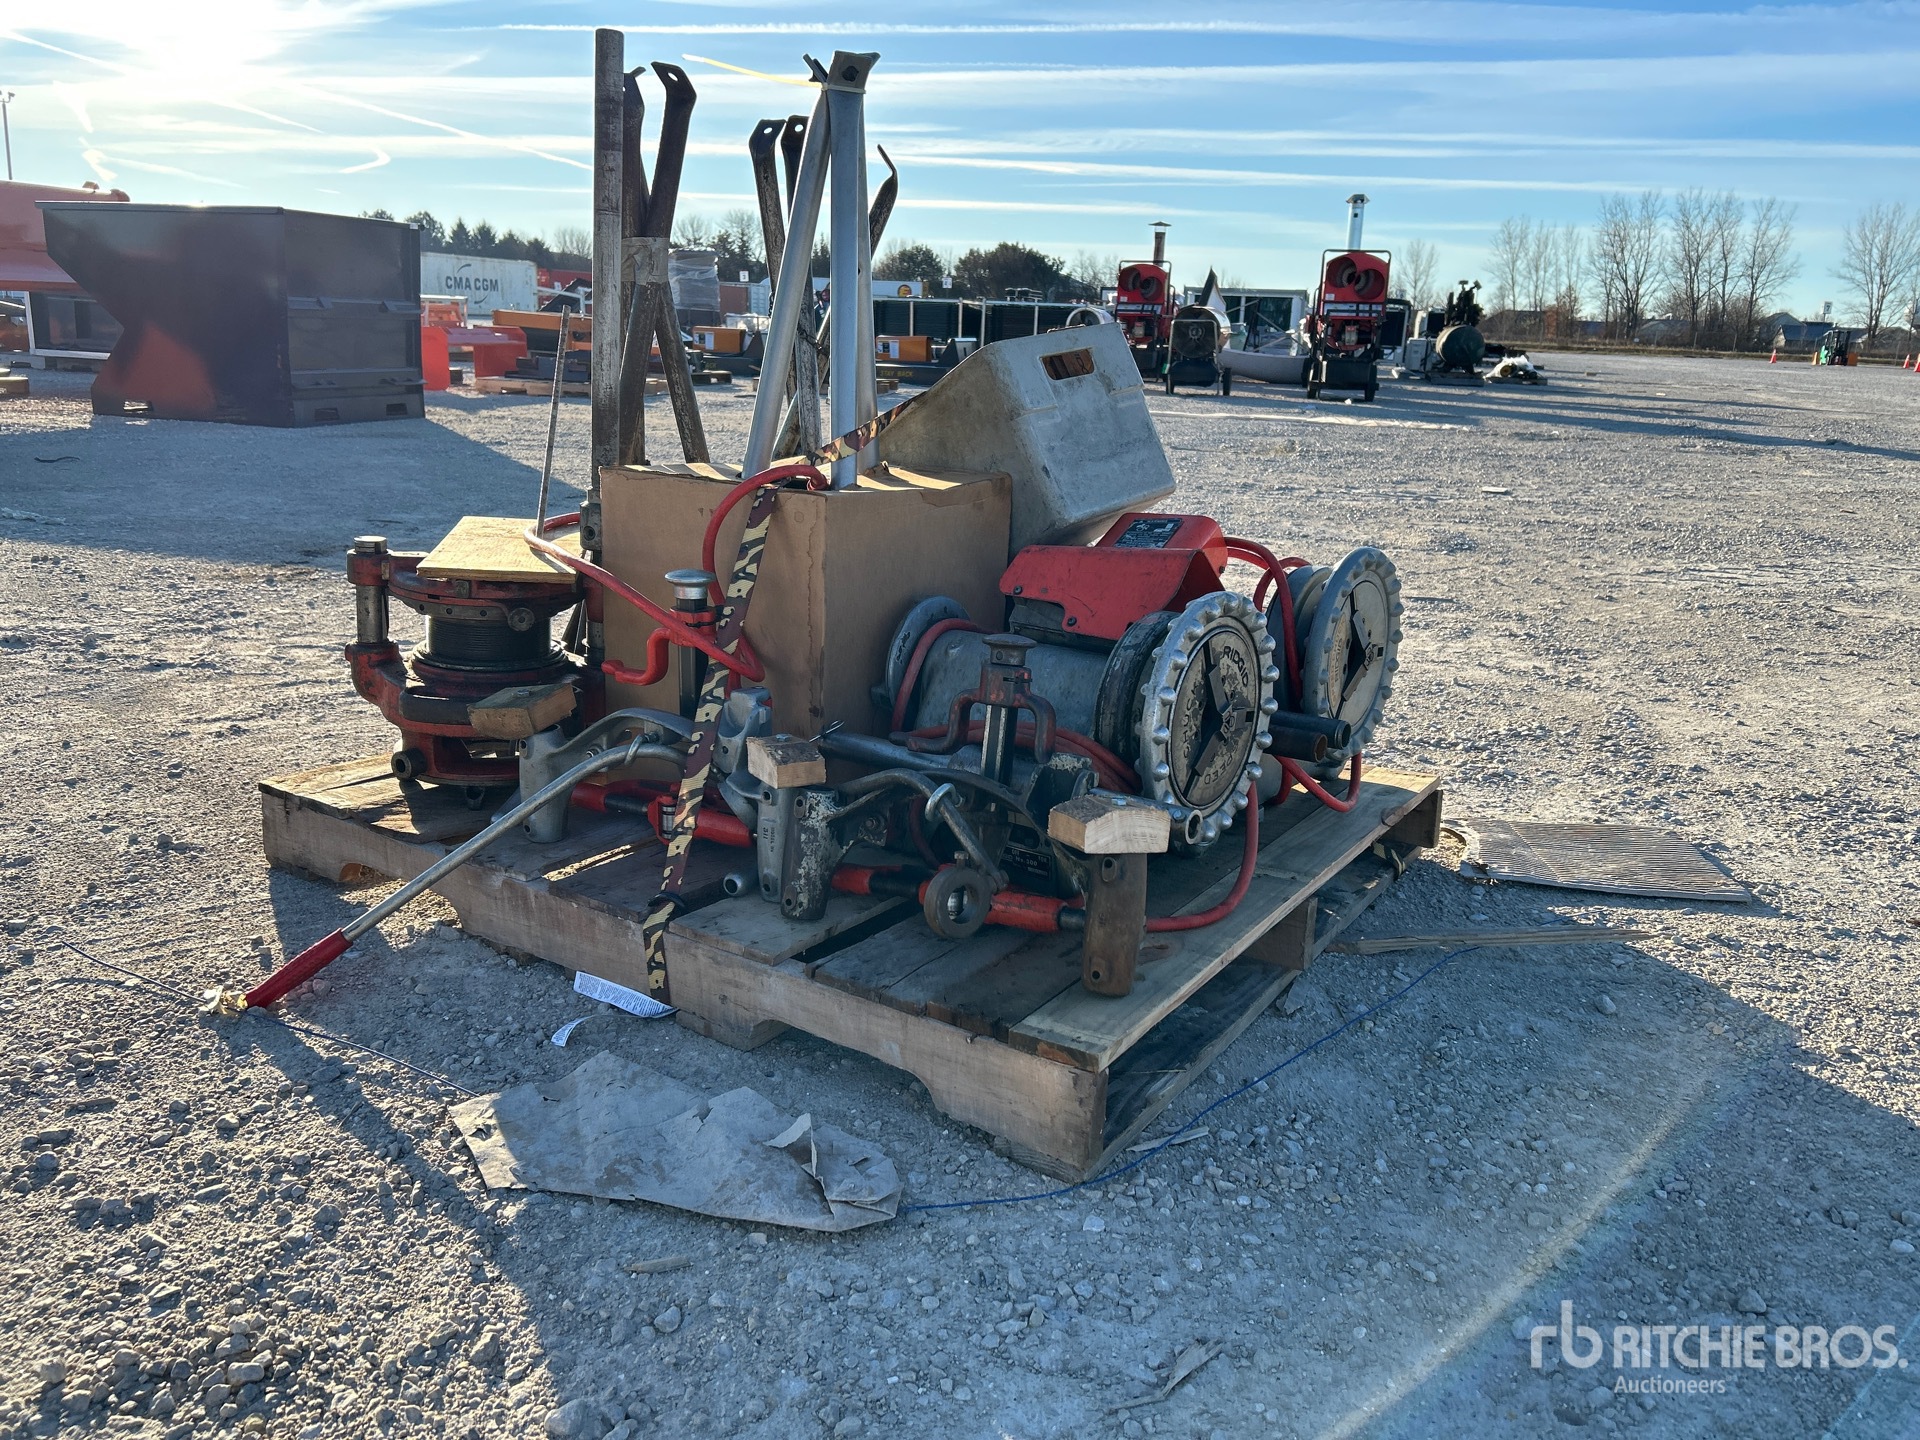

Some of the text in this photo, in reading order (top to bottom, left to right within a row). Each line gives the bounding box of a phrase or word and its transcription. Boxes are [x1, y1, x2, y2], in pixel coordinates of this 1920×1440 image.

[445, 276, 499, 292] CMA CGM
[1221, 645, 1249, 688] RIDGID
